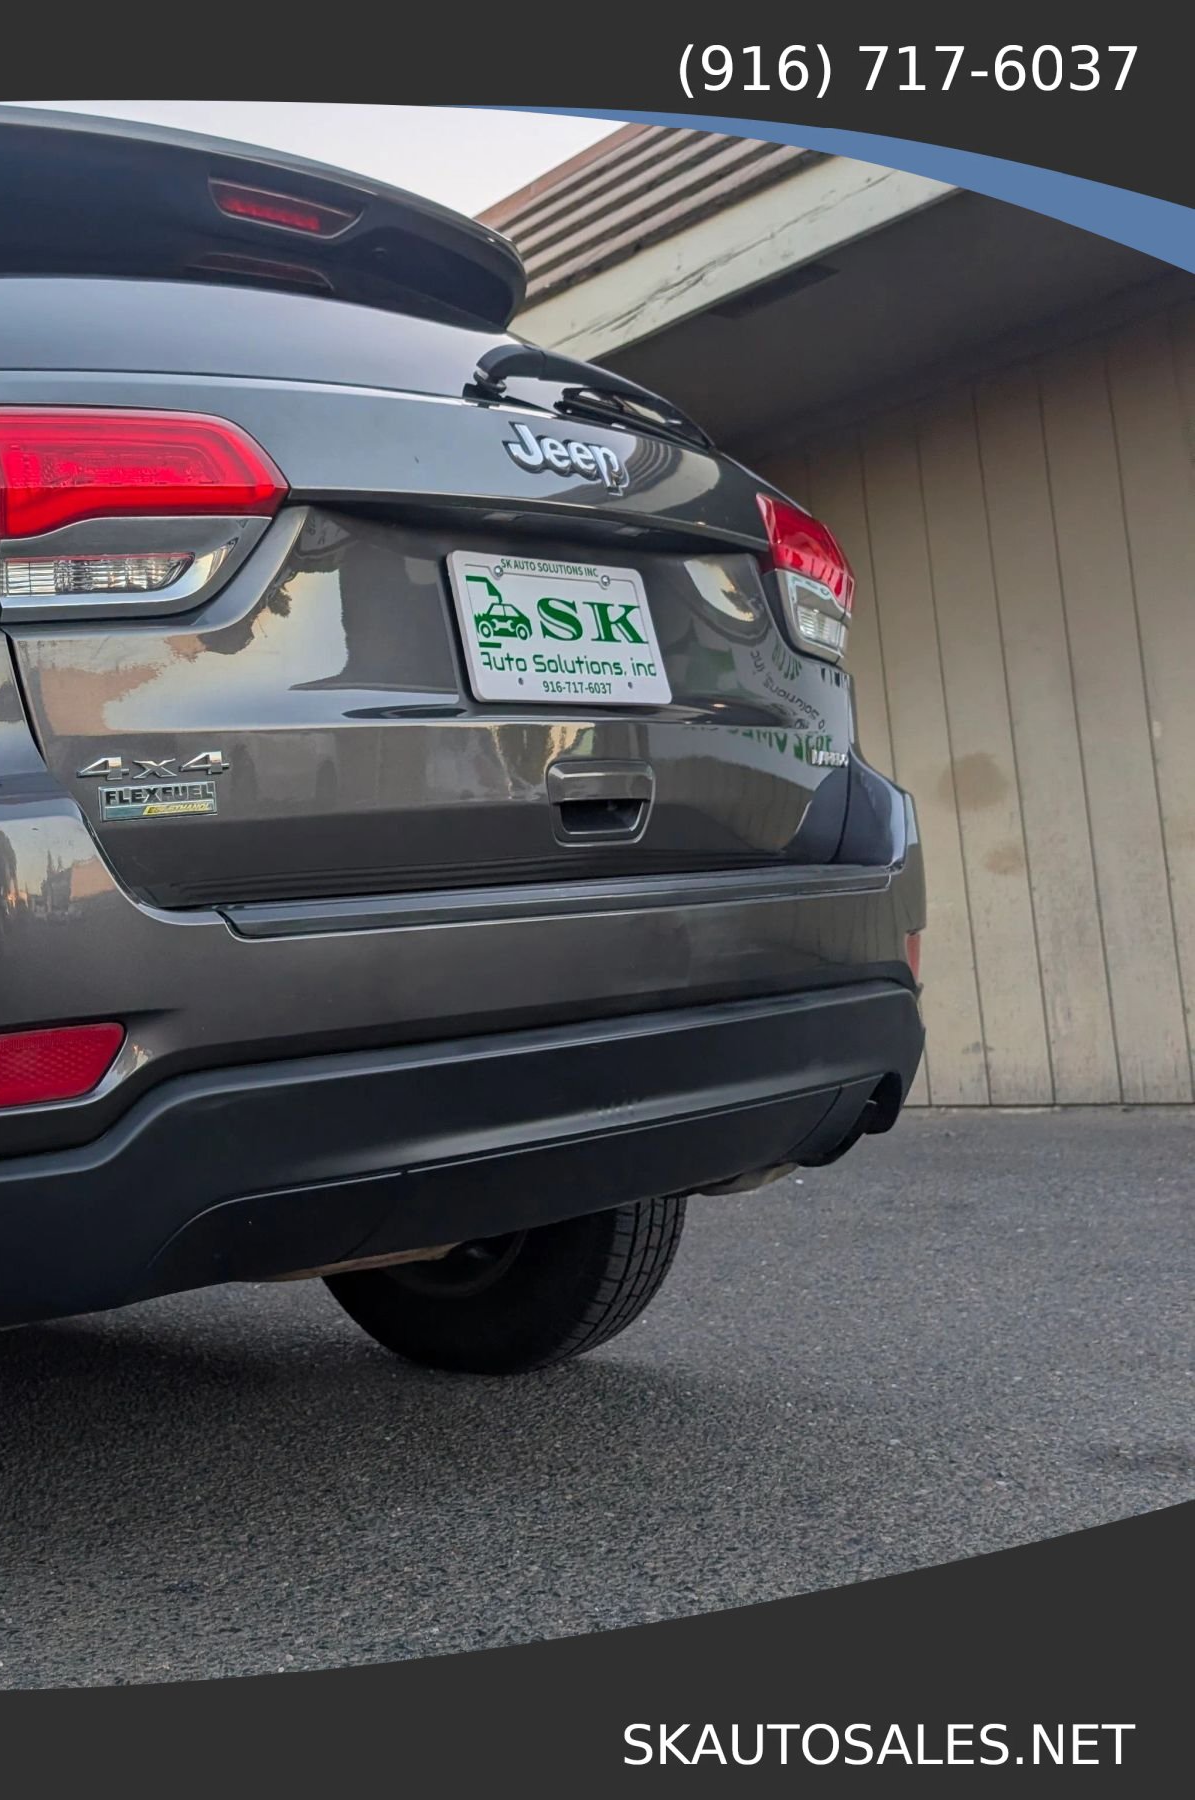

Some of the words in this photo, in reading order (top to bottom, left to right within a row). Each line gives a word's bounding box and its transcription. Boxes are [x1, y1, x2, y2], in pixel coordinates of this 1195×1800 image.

[502, 421, 624, 489] Jeep
[500, 558, 512, 570] SK
[514, 560, 537, 573] AUTO
[537, 563, 584, 577] SOLUTIONS
[585, 567, 599, 578] INC
[537, 597, 649, 645] SK
[542, 680, 612, 695] 916-717-6037
[76, 751, 230, 781] 4x4
[105, 783, 214, 805] FLEXFUEL
